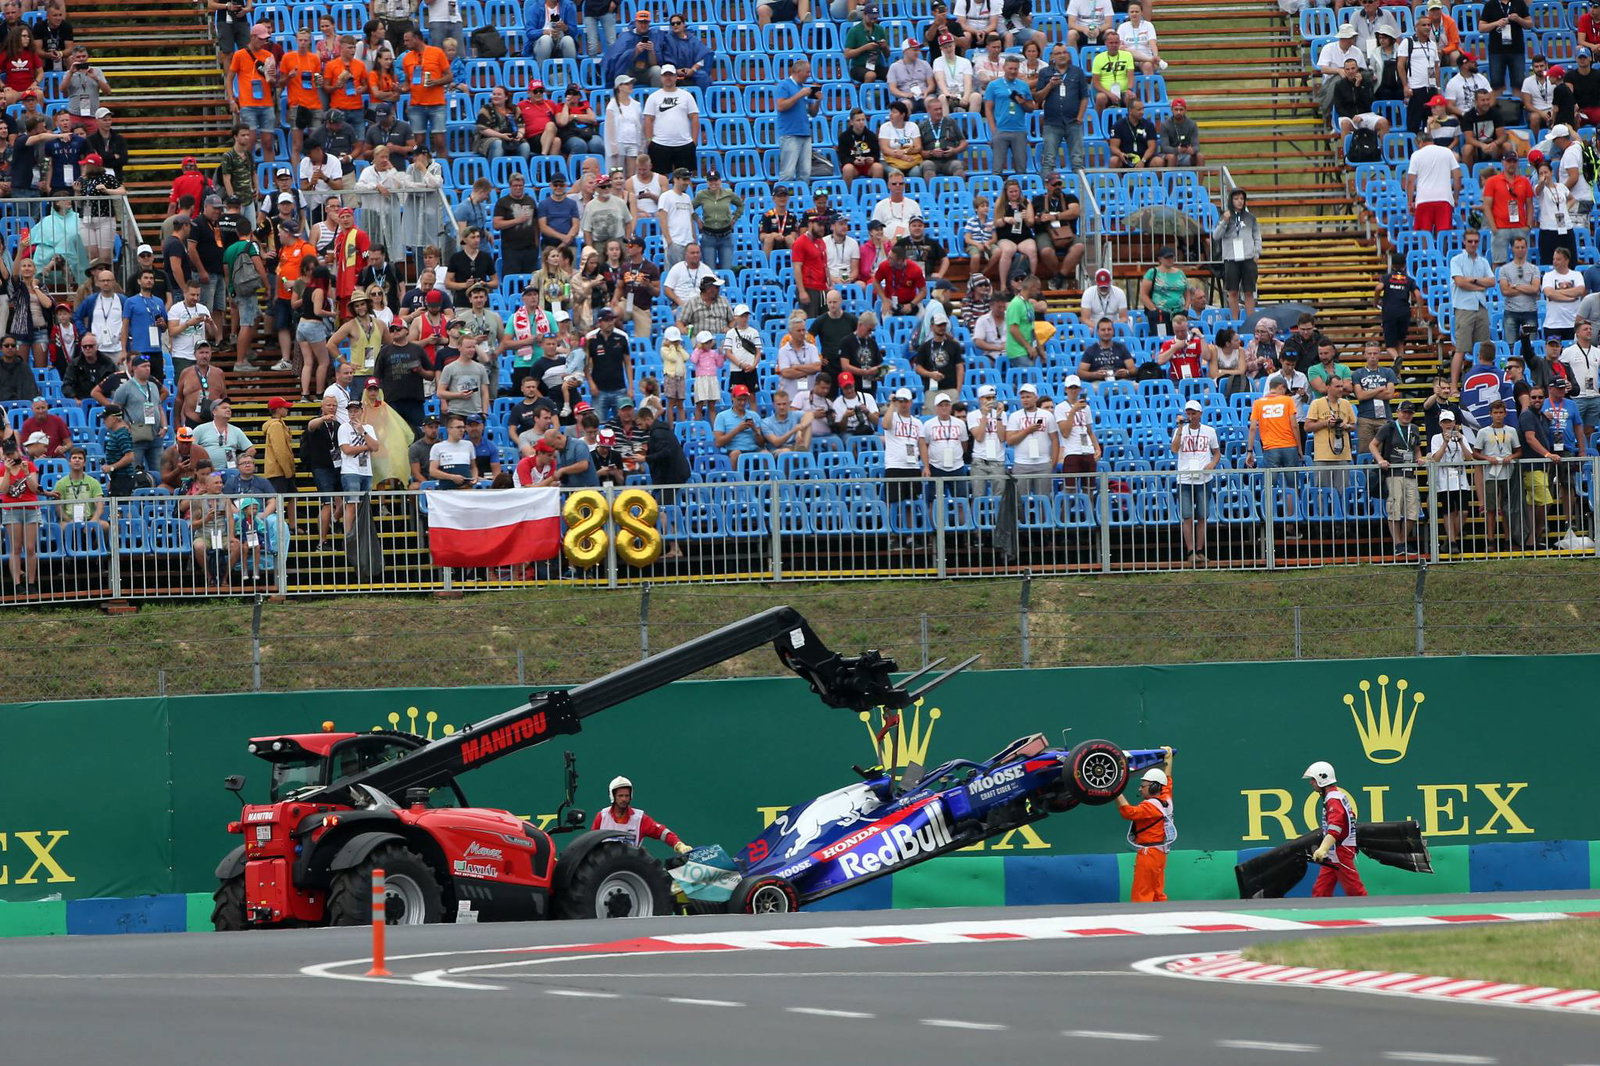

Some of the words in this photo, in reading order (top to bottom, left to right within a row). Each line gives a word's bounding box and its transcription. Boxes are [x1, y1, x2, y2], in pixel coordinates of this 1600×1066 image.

[1101, 61, 1127, 72] 46
[662, 97, 679, 105] NIKE
[1262, 403, 1285, 419] 33
[461, 711, 547, 765] MANITOU
[968, 764, 1025, 796] MOOSE
[980, 789, 997, 800] CRAFT
[1240, 782, 1535, 842] ROLEX
[822, 825, 881, 859] HONDA
[775, 860, 812, 877] MOOSE
